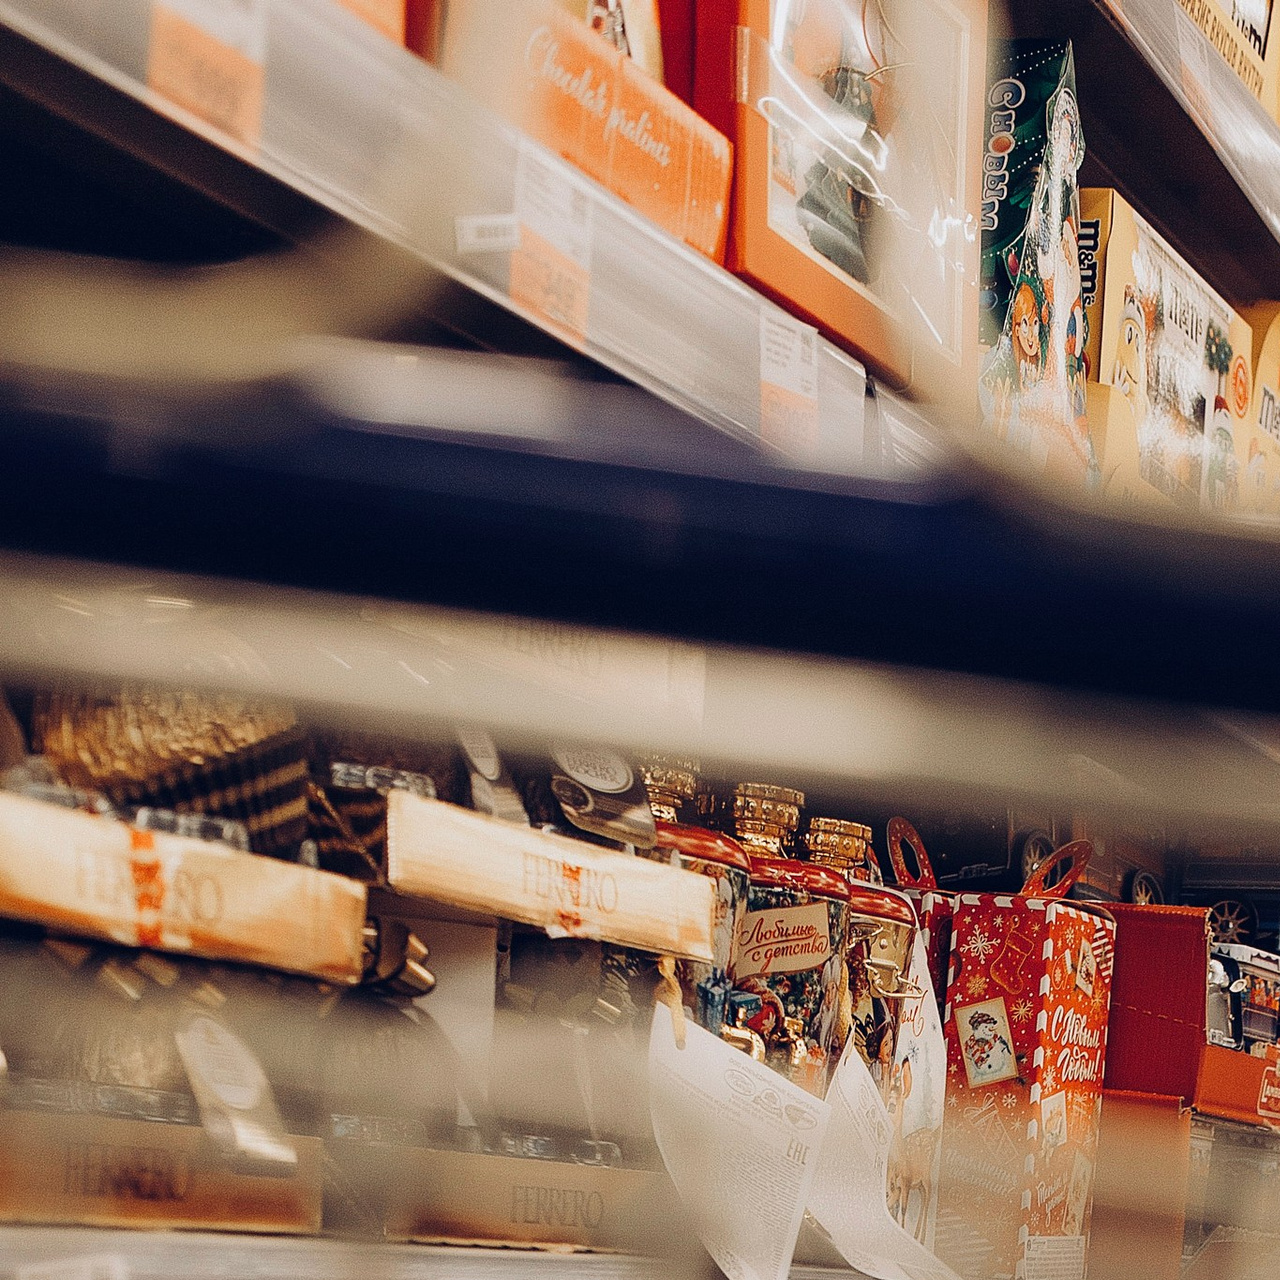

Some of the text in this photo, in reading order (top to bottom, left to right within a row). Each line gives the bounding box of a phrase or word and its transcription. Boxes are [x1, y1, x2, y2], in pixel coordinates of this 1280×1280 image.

[739, 917, 818, 946] Любимые
[762, 936, 831, 971] детства
[1051, 1005, 1100, 1049] С Новым
[1057, 1045, 1100, 1083] Годом!
[510, 1184, 605, 1229] FERRERO
